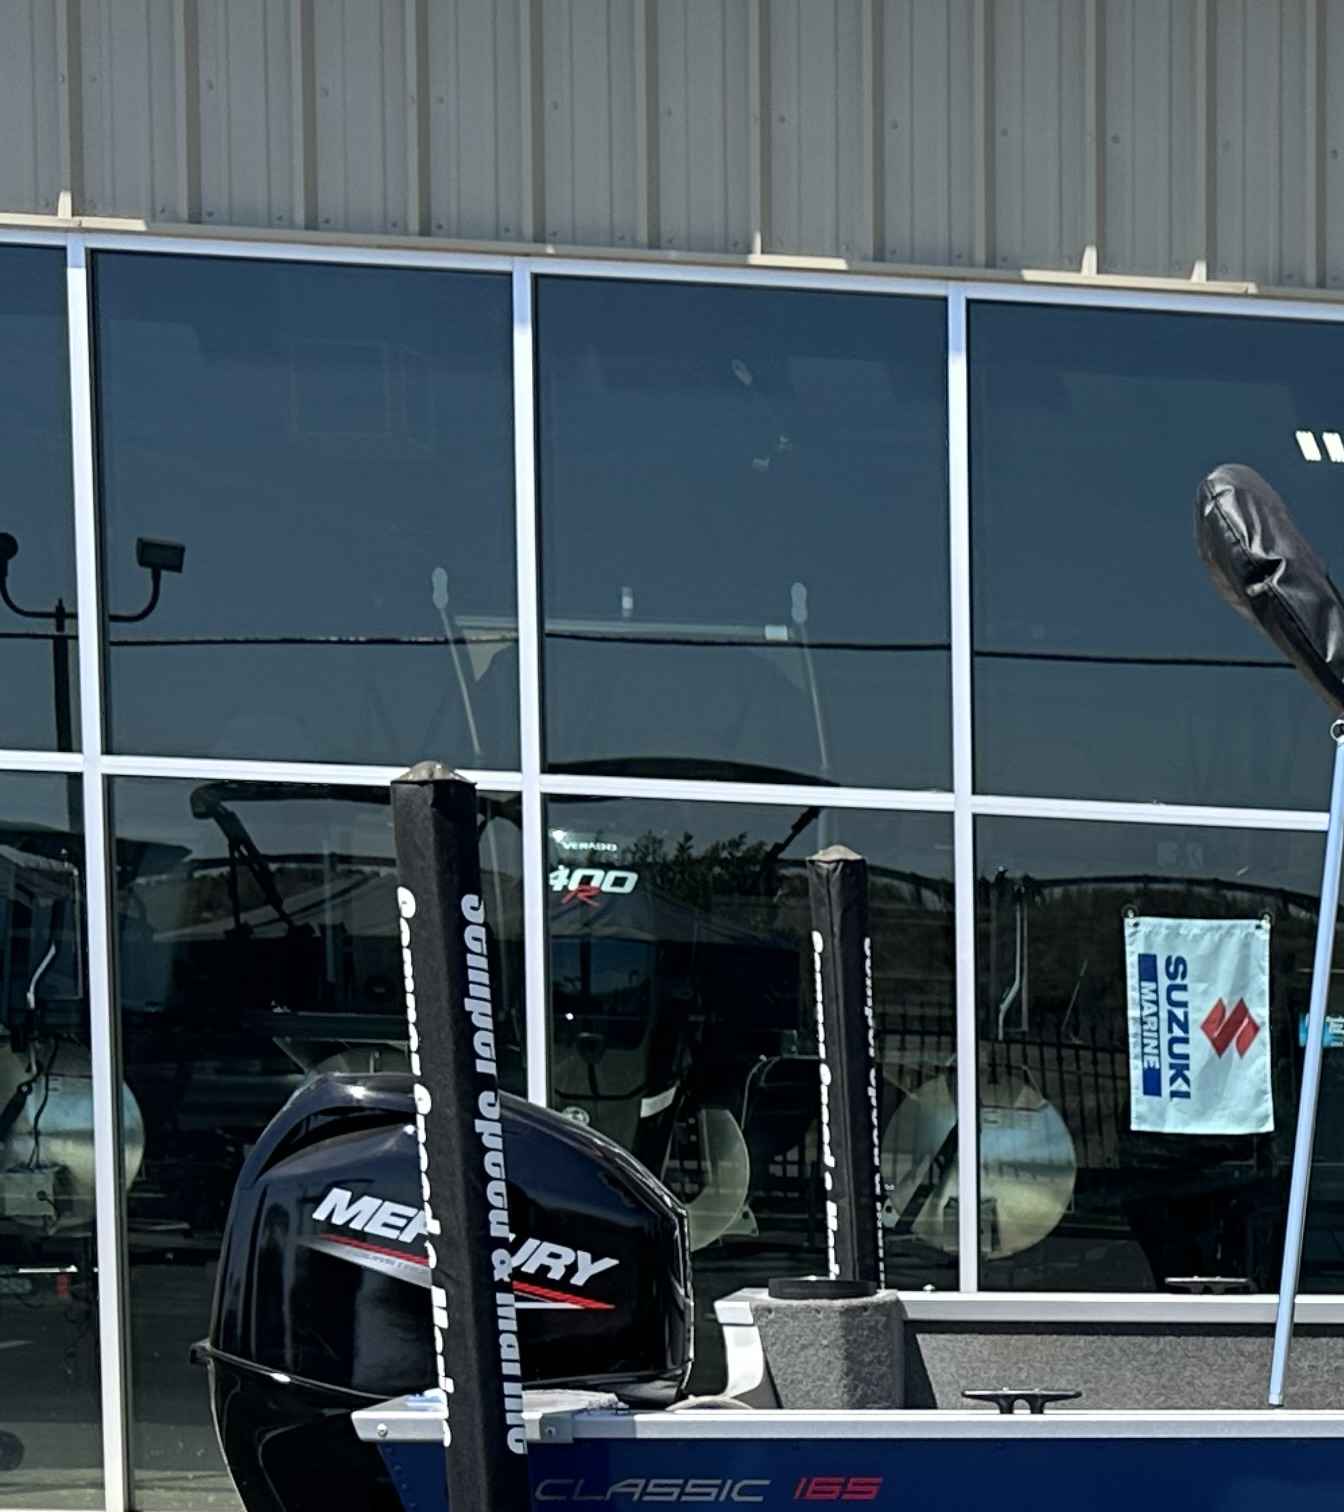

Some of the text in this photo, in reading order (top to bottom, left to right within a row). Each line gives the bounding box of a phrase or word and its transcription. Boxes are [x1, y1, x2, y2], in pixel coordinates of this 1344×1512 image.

[549, 865, 639, 894] 400
[1138, 981, 1161, 1070] MARINE
[1165, 954, 1192, 1100] SUZUKI
[533, 1476, 884, 1502] CLASSIC 165
